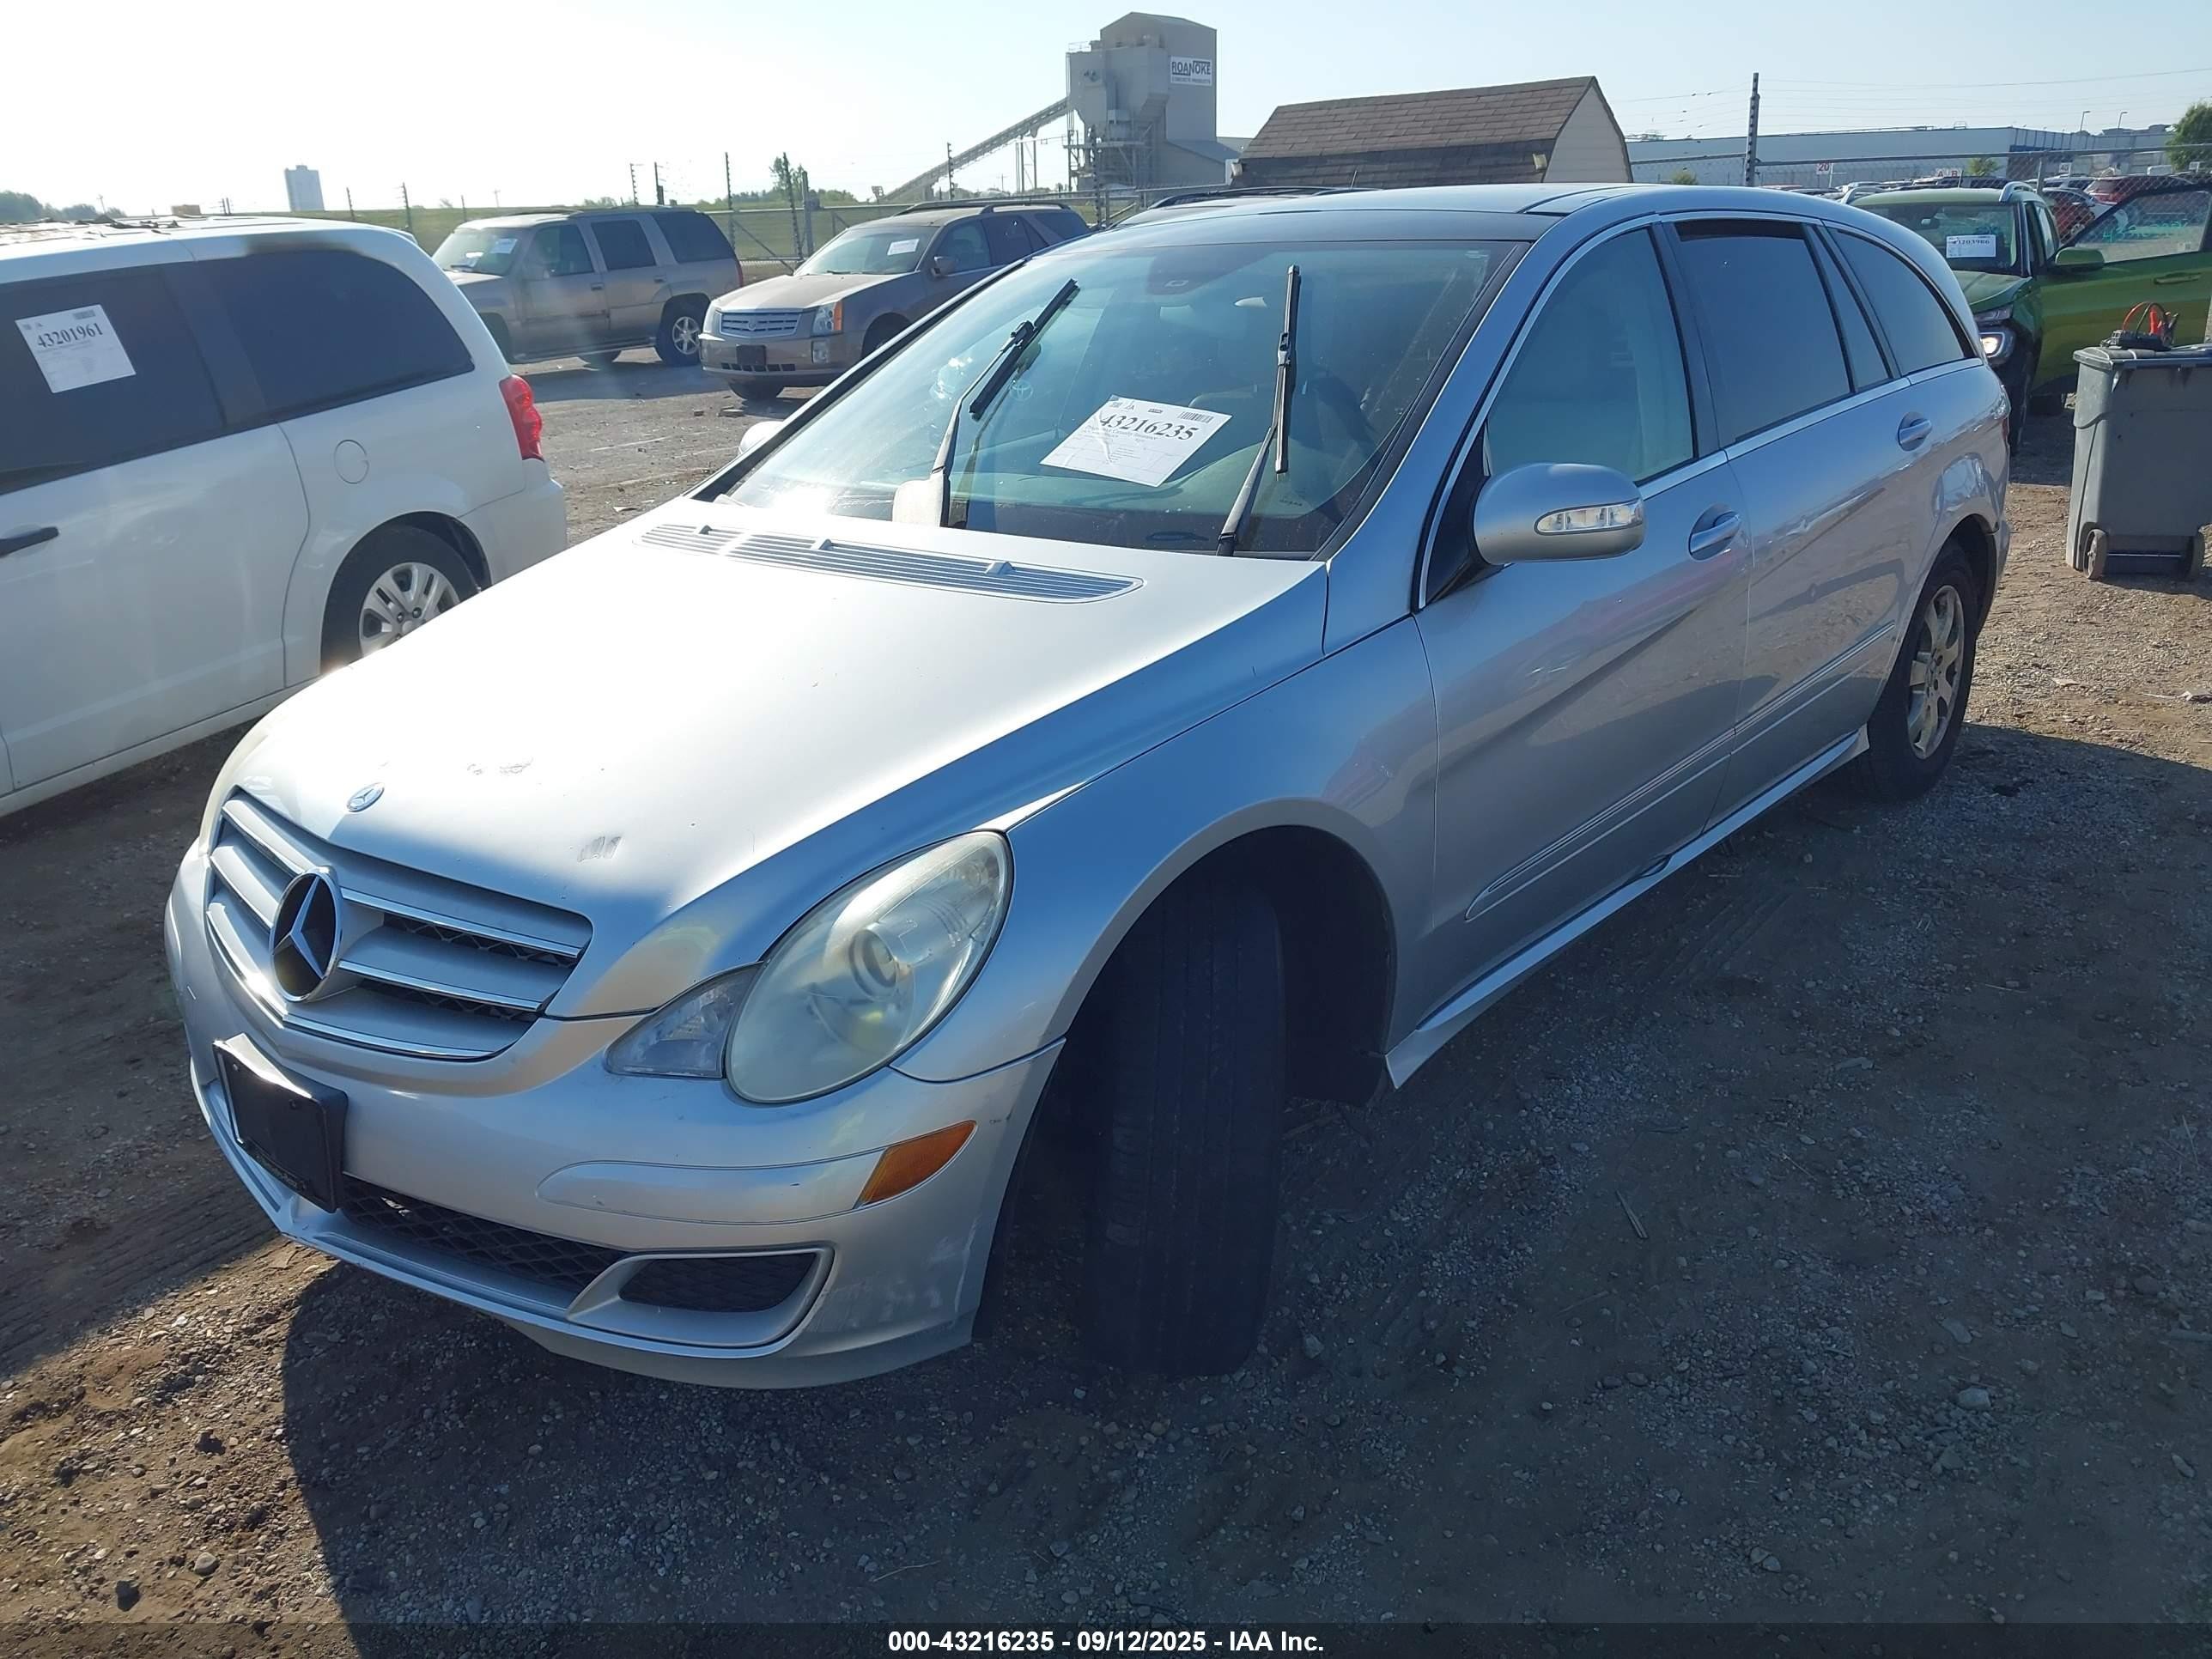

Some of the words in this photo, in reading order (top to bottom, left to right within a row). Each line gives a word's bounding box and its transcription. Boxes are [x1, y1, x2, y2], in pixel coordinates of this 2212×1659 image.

[1171, 61, 1212, 76] ROANOKE
[1818, 161, 1830, 172] 20
[38, 323, 103, 348] 43201961
[1100, 414, 1200, 440] 43216235
